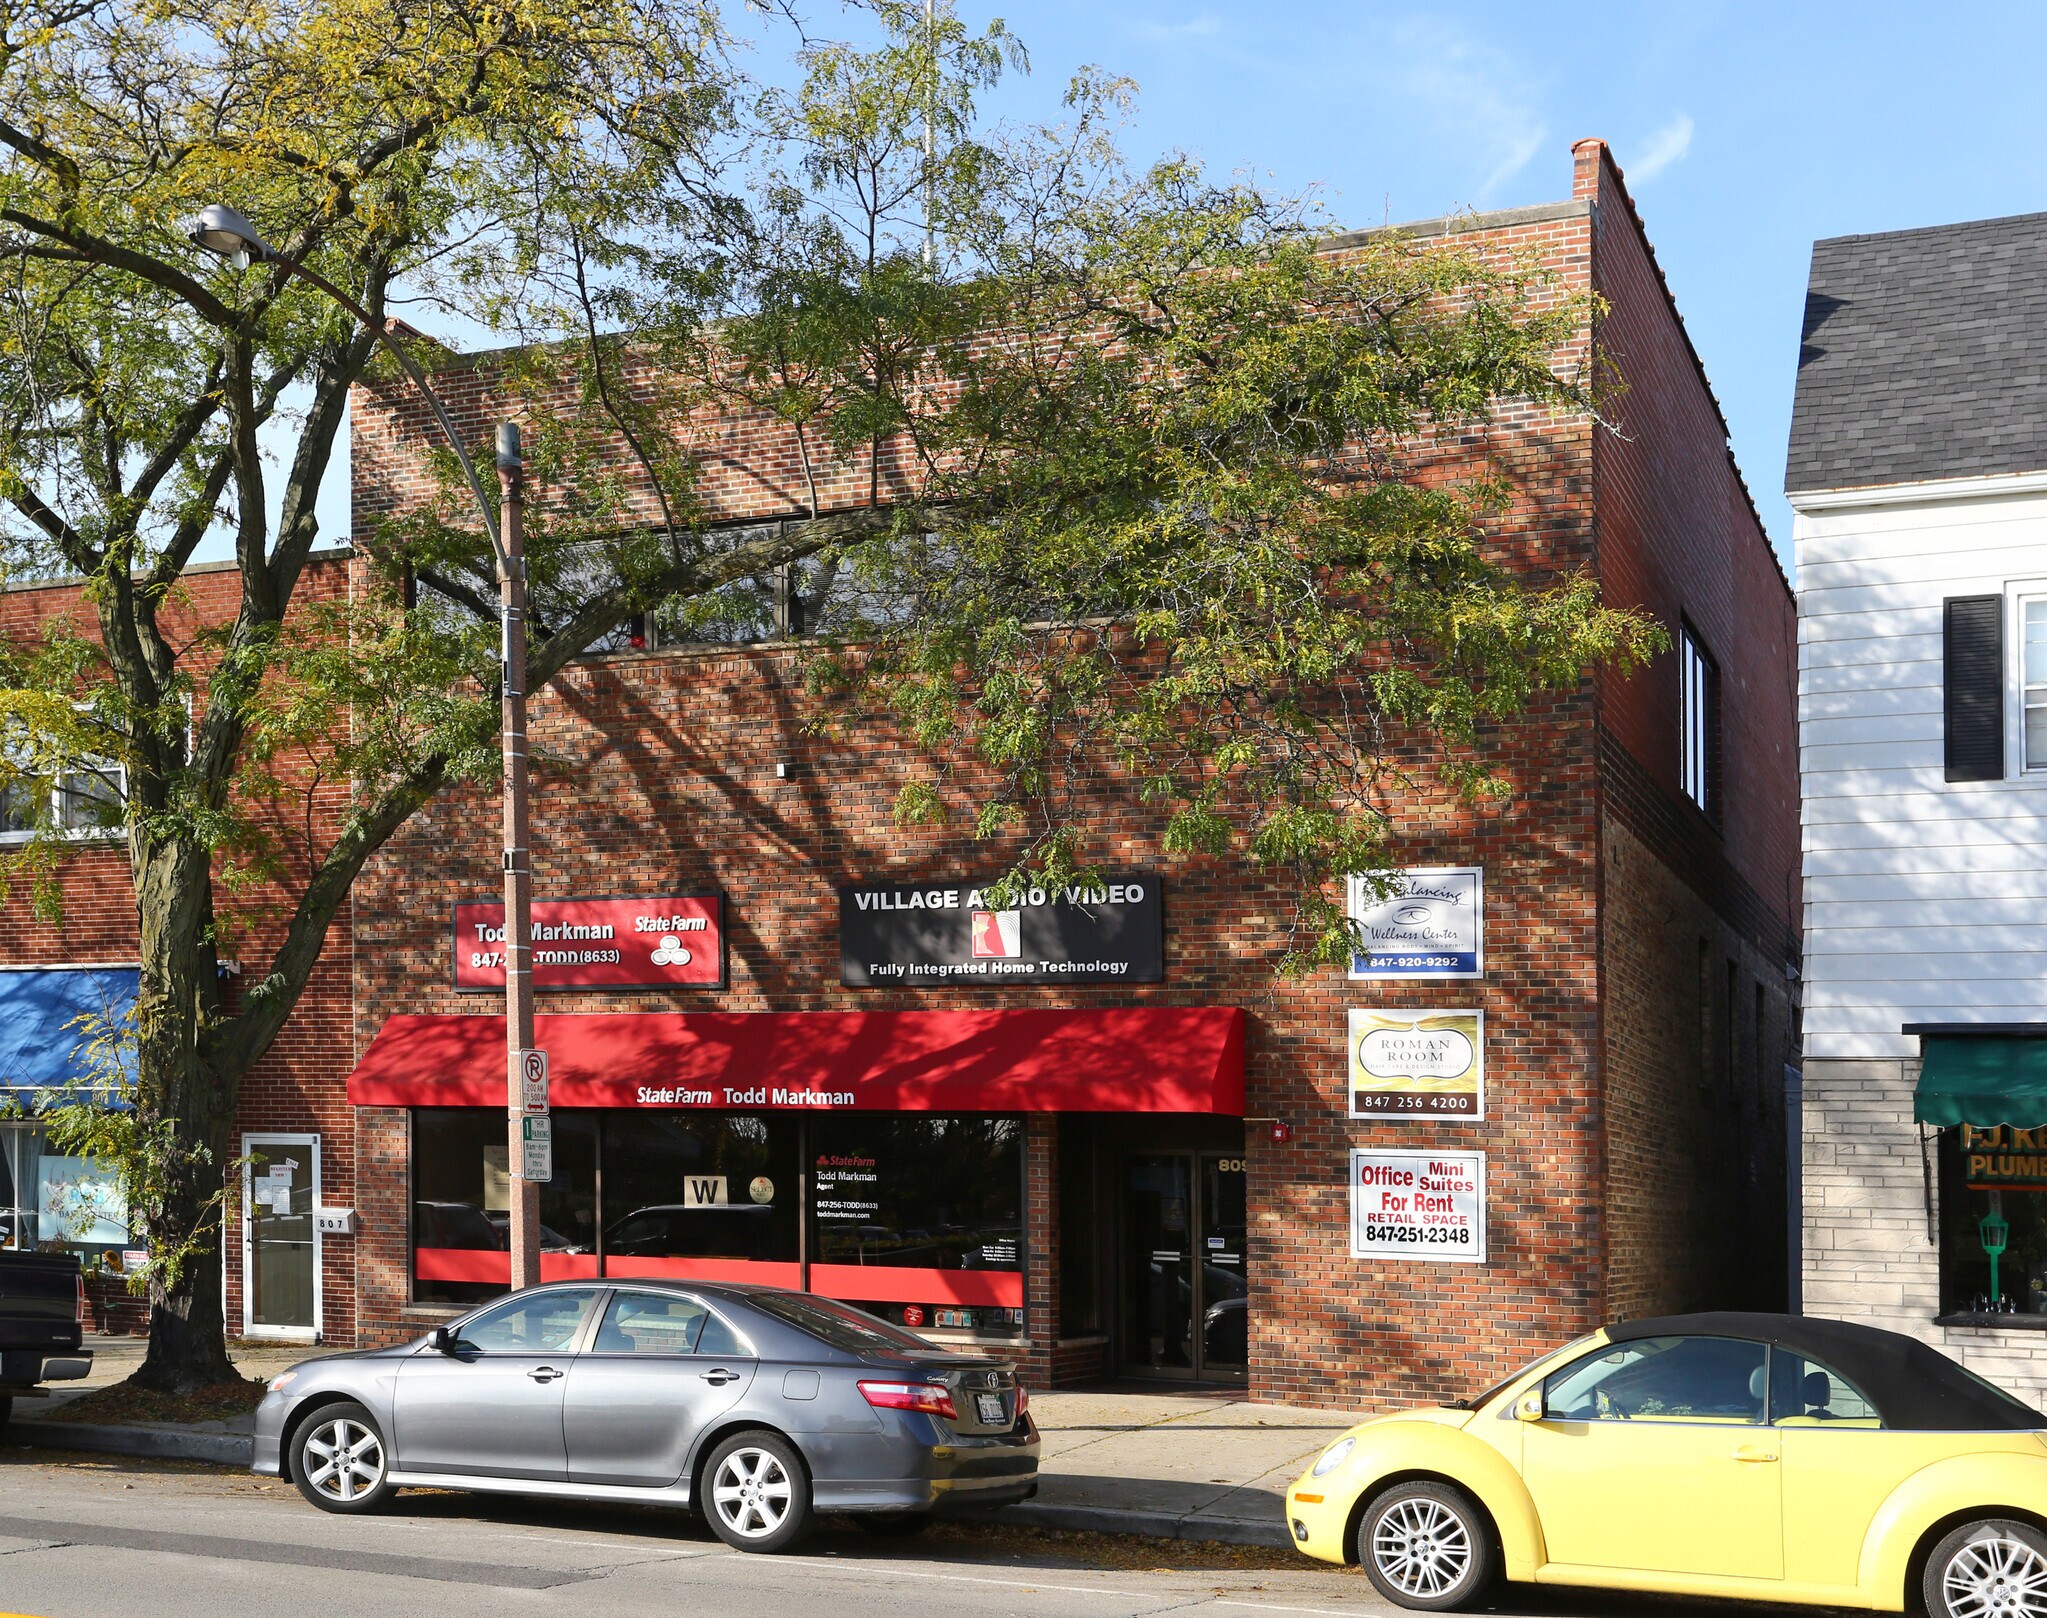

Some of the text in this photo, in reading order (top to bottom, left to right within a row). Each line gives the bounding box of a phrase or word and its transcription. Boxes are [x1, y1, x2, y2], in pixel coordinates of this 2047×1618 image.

[854, 884, 1145, 910] VILLAGE ADIO VIDEO
[474, 922, 614, 942] Tod Markman
[1371, 926, 1459, 940] Wellness Center
[870, 960, 1129, 977] Fully Integrated Home Technology
[1370, 957, 1459, 967] 847-920-9292
[1381, 1039, 1451, 1049] ROMAN
[1387, 1051, 1444, 1062] ROOM
[723, 1087, 766, 1104] Todd
[771, 1088, 855, 1105] Markman
[1365, 1096, 1468, 1109] 847 256 4200
[528, 1151, 546, 1160] Monday
[532, 1160, 543, 1168] thru
[1429, 1162, 1464, 1176] Mini
[527, 1168, 548, 1178] Saturday
[816, 1171, 877, 1182] Todd Markman
[1361, 1165, 1414, 1186] Office
[816, 1182, 834, 1191] Agent
[1419, 1177, 1474, 1192] Suites
[692, 1180, 719, 1204] W
[1381, 1192, 1454, 1213] For Rent
[816, 1211, 870, 1219] toddmarkman.com
[1367, 1213, 1468, 1225] RETAIL SPACE
[319, 1219, 343, 1229] 807
[1366, 1225, 1470, 1244] 847-251-2348
